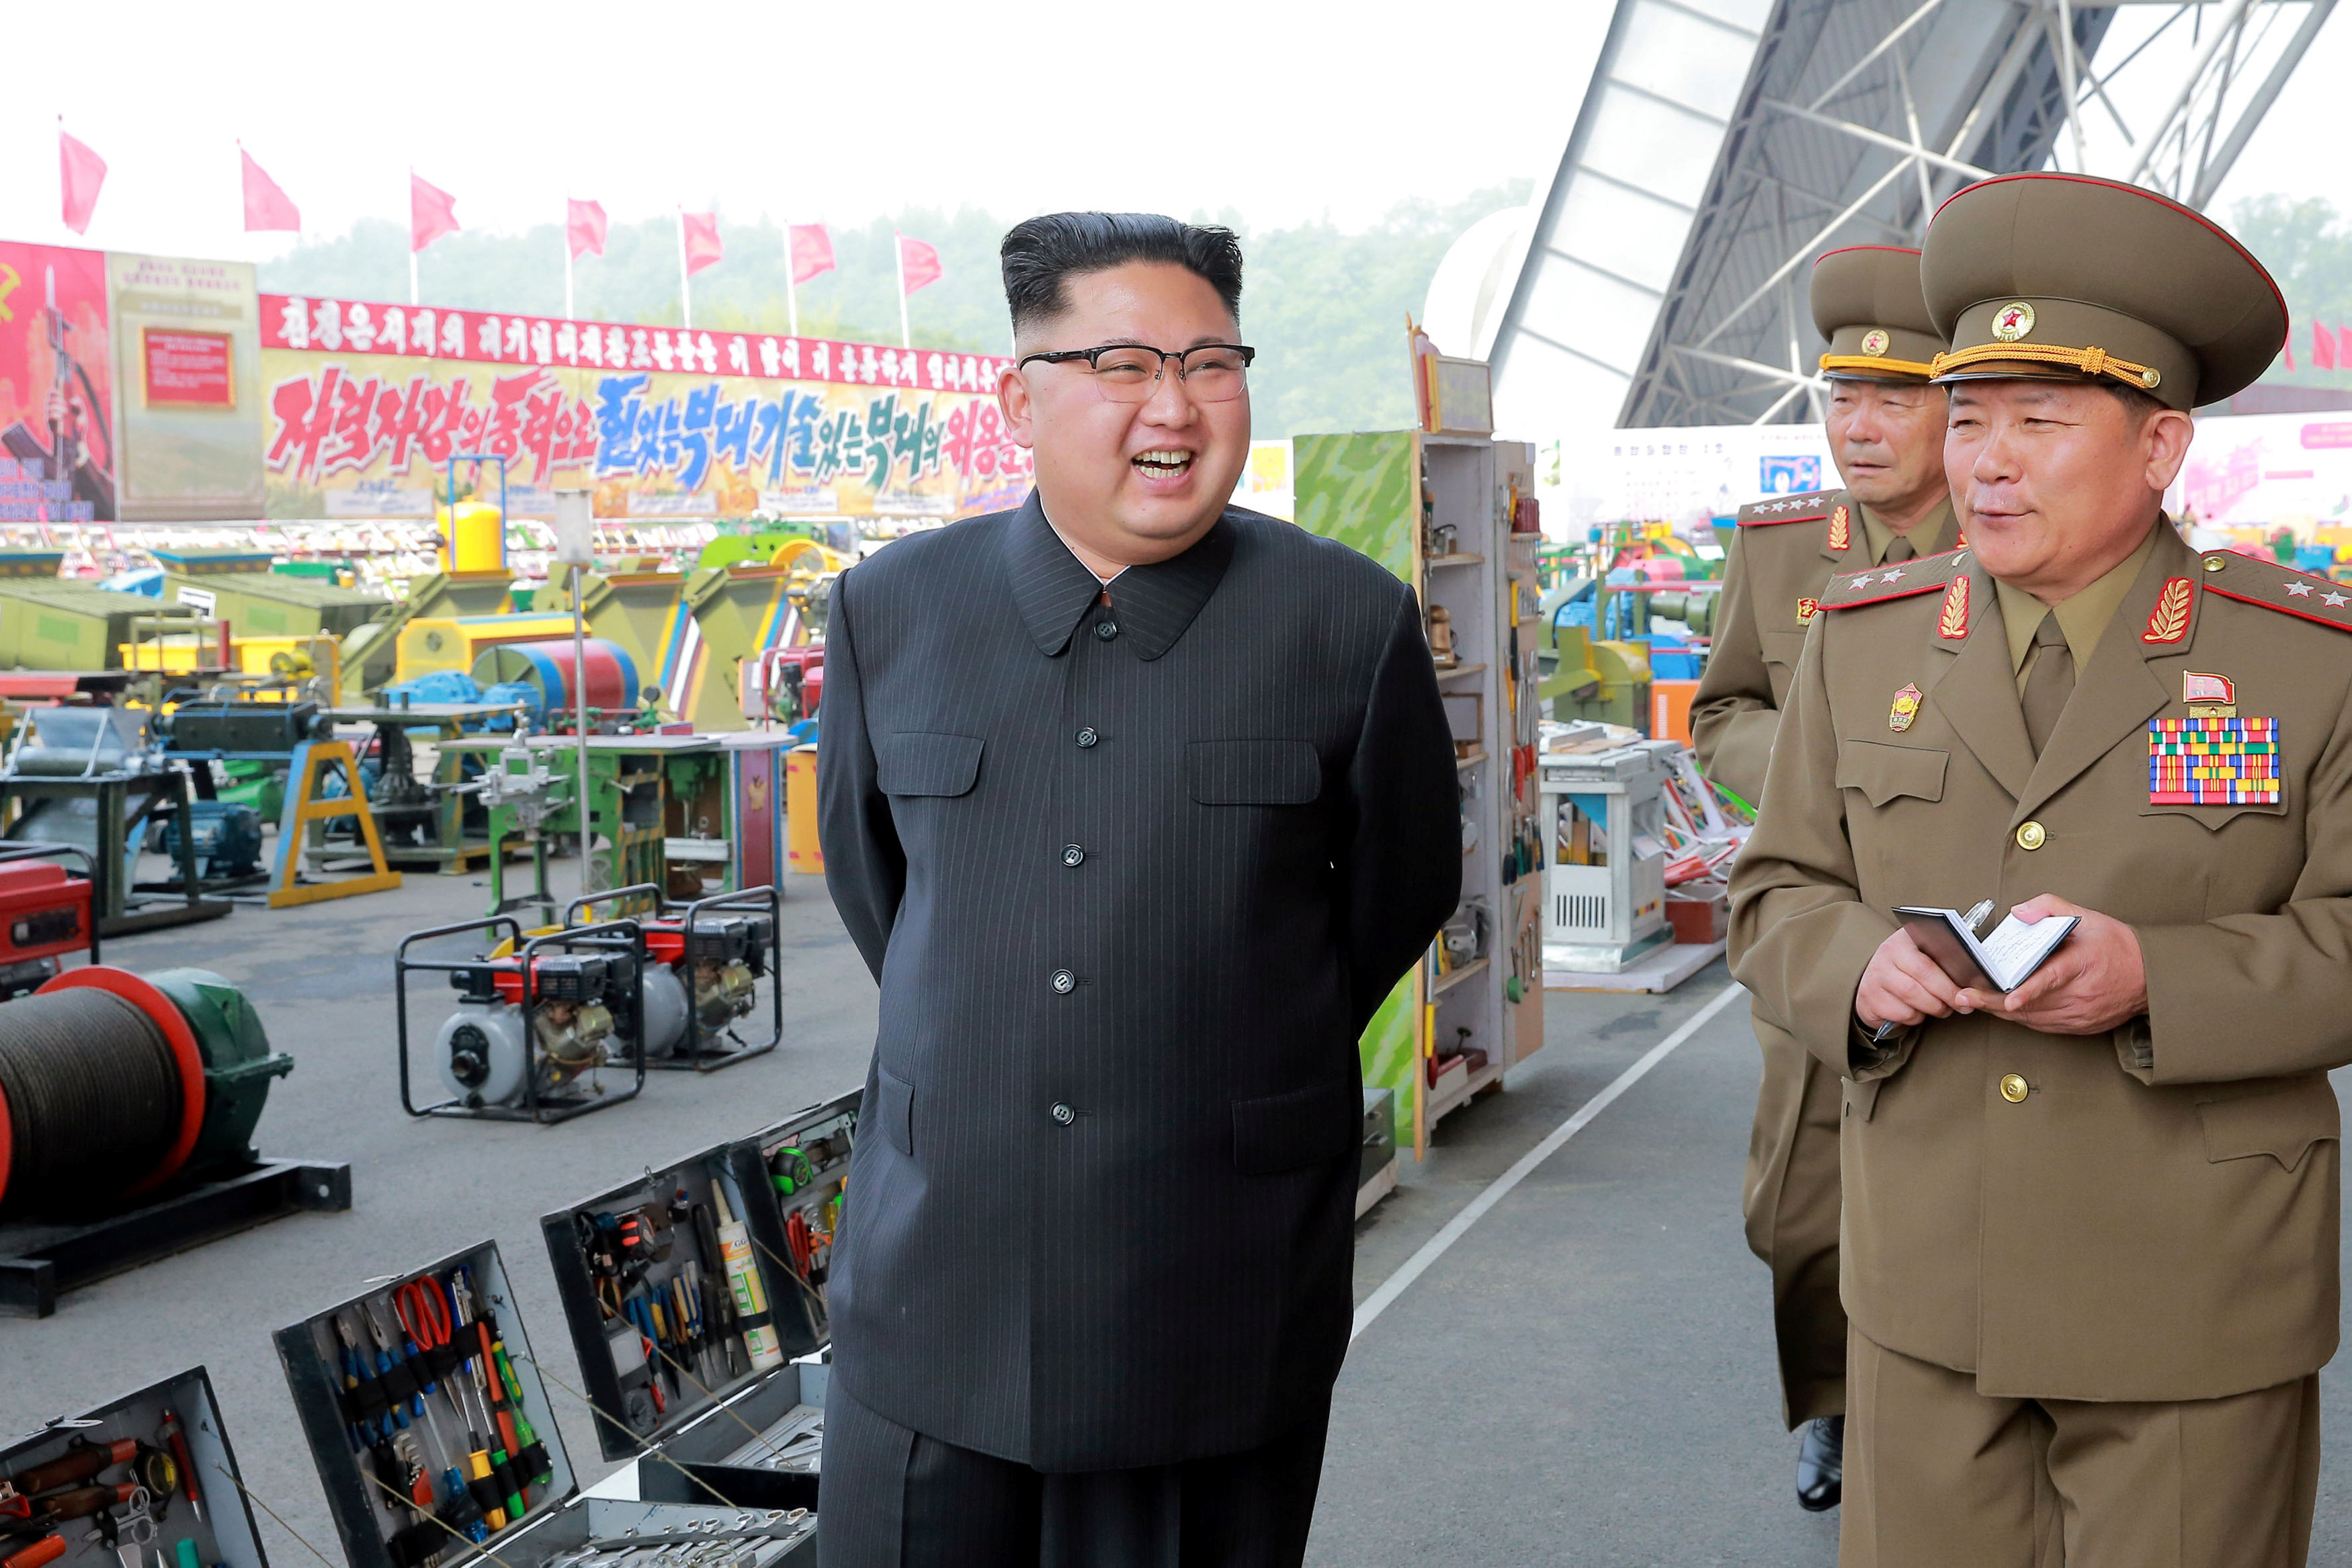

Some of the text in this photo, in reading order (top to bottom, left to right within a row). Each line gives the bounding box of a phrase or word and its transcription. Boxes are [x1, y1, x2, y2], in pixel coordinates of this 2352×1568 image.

[277, 296, 465, 357] 김정은시대의
[728, 335, 750, 376] 더
[759, 337, 800, 378] 많이
[812, 341, 830, 380] 더
[839, 344, 918, 388] 훌륭하게
[267, 364, 491, 485] 자력자강의
